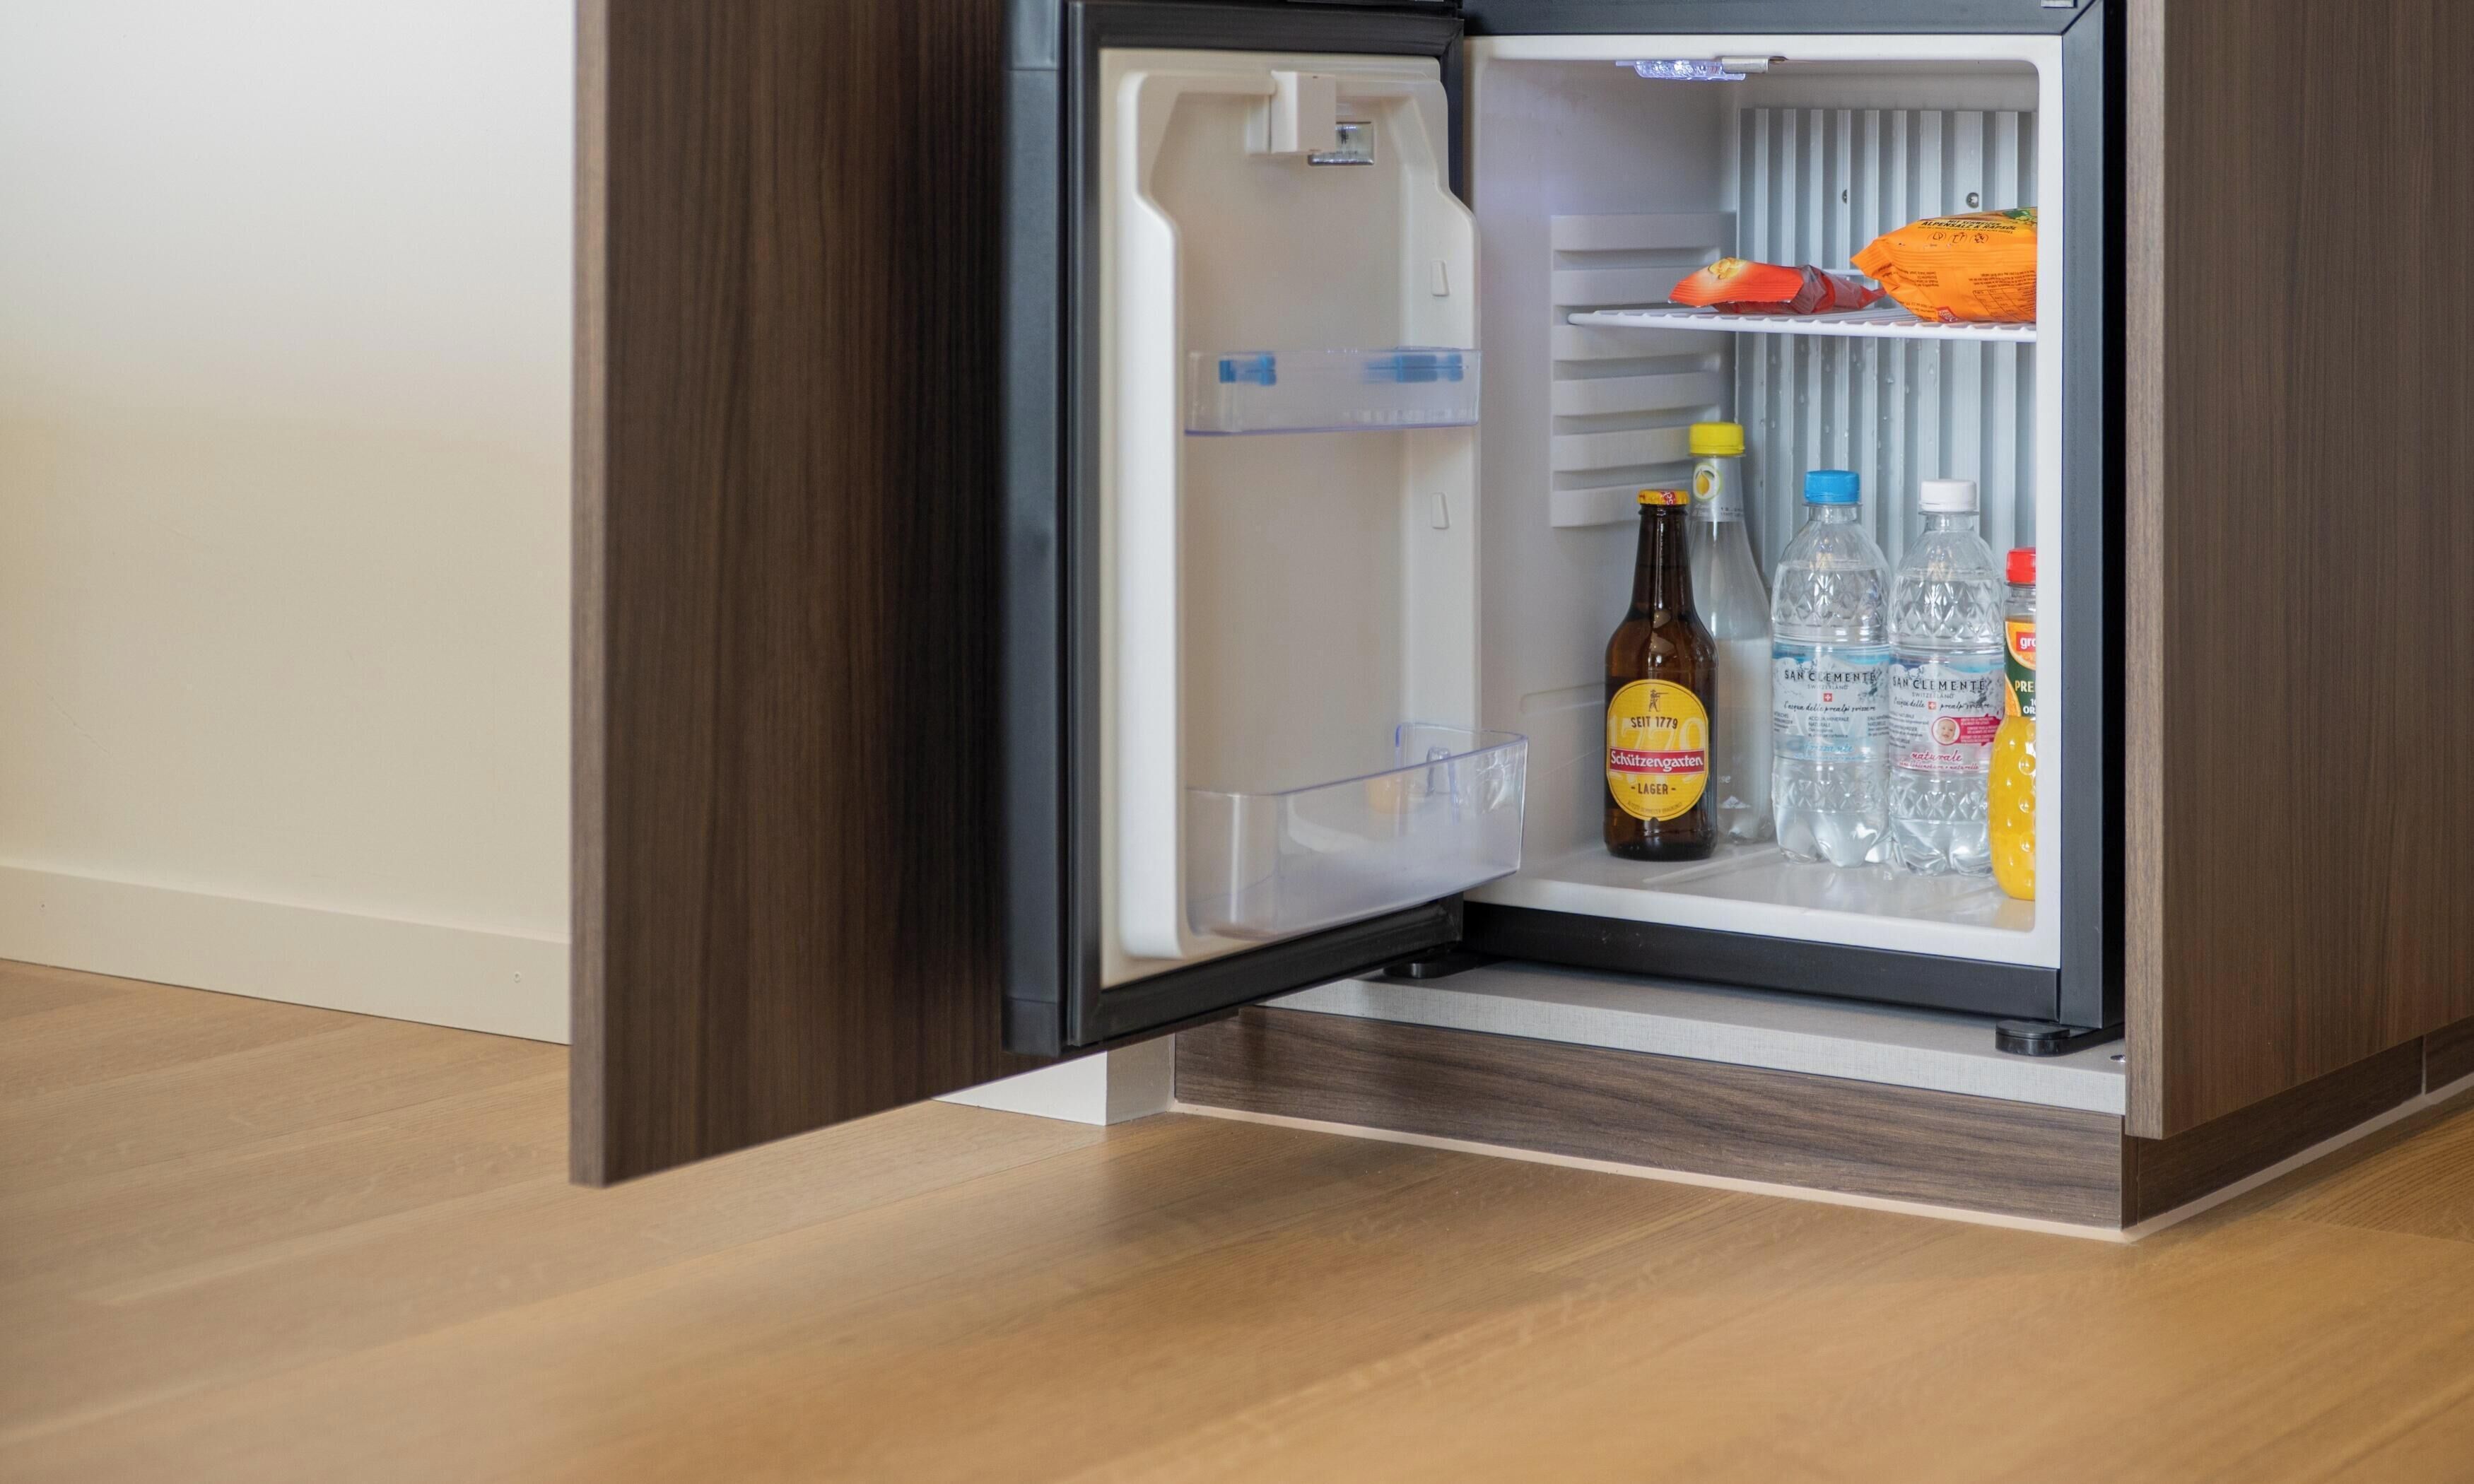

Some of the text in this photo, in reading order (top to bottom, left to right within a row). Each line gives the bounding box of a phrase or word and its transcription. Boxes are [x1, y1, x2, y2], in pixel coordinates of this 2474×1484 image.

[1784, 670, 1877, 682] SAN CLEMENTE
[1893, 676, 1984, 690] SAN CLEMENTE
[2015, 680, 2034, 693] PRE
[1824, 704, 1851, 714] prealpi
[1631, 716, 1678, 729] SEIT 1779
[1610, 750, 1704, 772] Schützengarten
[1911, 749, 1963, 762] naturale
[1638, 783, 1669, 794] LAGER
